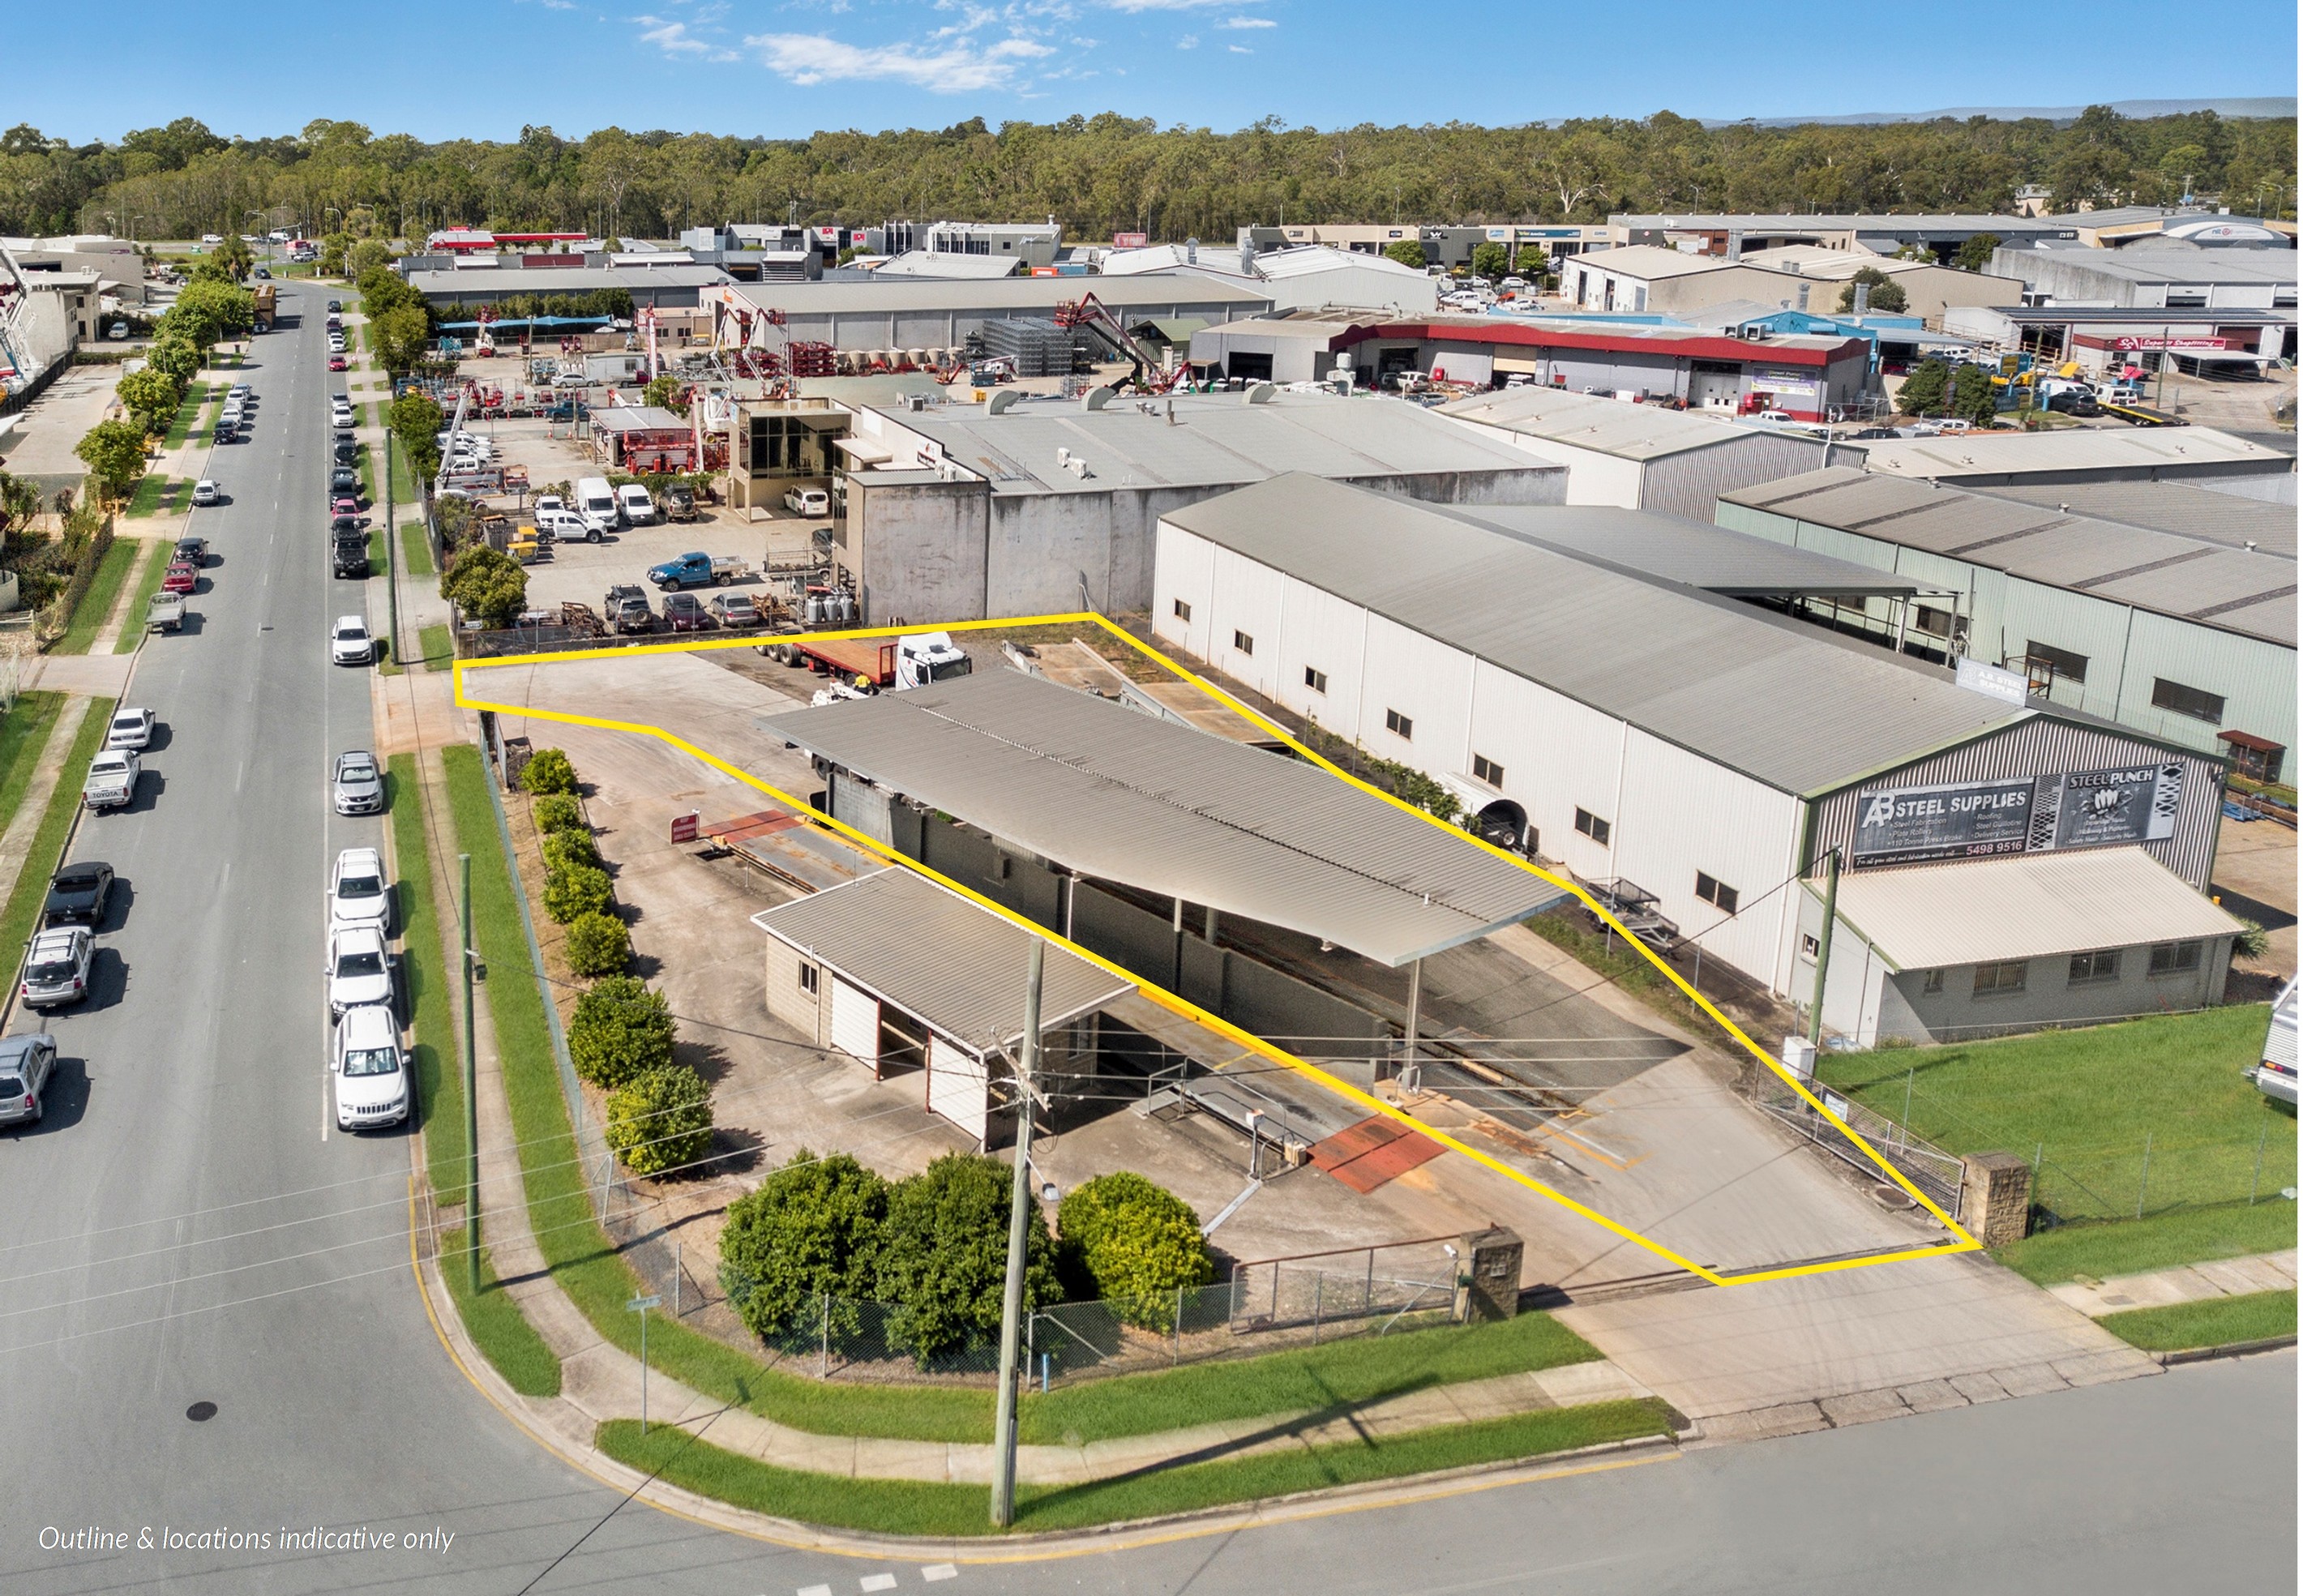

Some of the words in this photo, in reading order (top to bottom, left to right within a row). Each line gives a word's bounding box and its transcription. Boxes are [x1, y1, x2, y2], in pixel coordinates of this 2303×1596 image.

[1979, 678, 2020, 697] SUPPLIES
[1996, 675, 2023, 691] STEEL
[2069, 773, 2108, 789] STEEL
[2109, 769, 2154, 785] PUNCH
[1896, 798, 1946, 818] STEEL
[1950, 791, 2027, 812] SUPPLIES
[1977, 812, 2002, 820] Roofing
[1894, 820, 1910, 828] Steel
[1911, 818, 1947, 827] Fabrication
[1976, 822, 1992, 830] Steel
[1993, 819, 2023, 828] Guillotine
[1892, 829, 1908, 838] Plate
[1910, 828, 1933, 837] Rollers
[1974, 830, 2000, 839] Delivery
[2001, 828, 2024, 837] Service
[1924, 835, 1943, 845] Press
[1944, 834, 1963, 842] Brake
[1966, 843, 1994, 856] 5498
[1996, 841, 2023, 853] 9516
